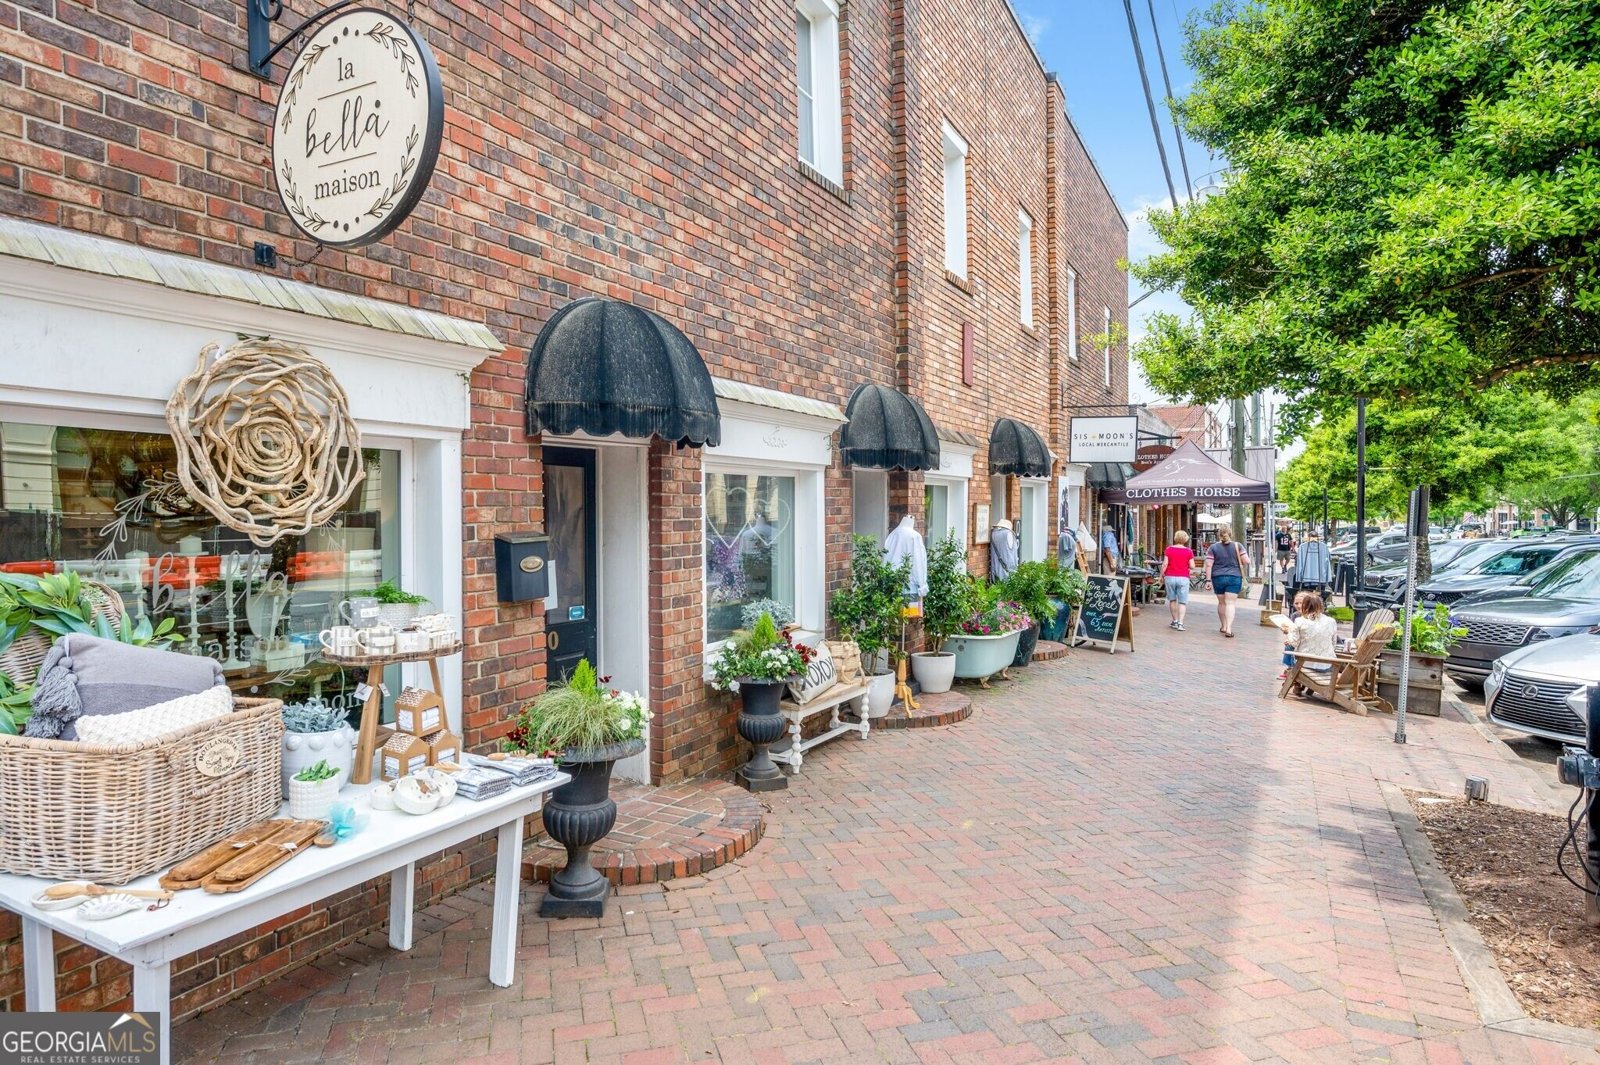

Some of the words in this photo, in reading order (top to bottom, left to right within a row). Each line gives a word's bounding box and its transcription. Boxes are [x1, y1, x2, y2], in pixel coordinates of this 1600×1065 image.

[337, 57, 355, 82] la
[306, 95, 390, 158] bella
[314, 169, 381, 200] maison
[1126, 487, 1187, 499] CLOTHES
[1194, 487, 1241, 497] HORSE
[1280, 537, 1289, 546] 12
